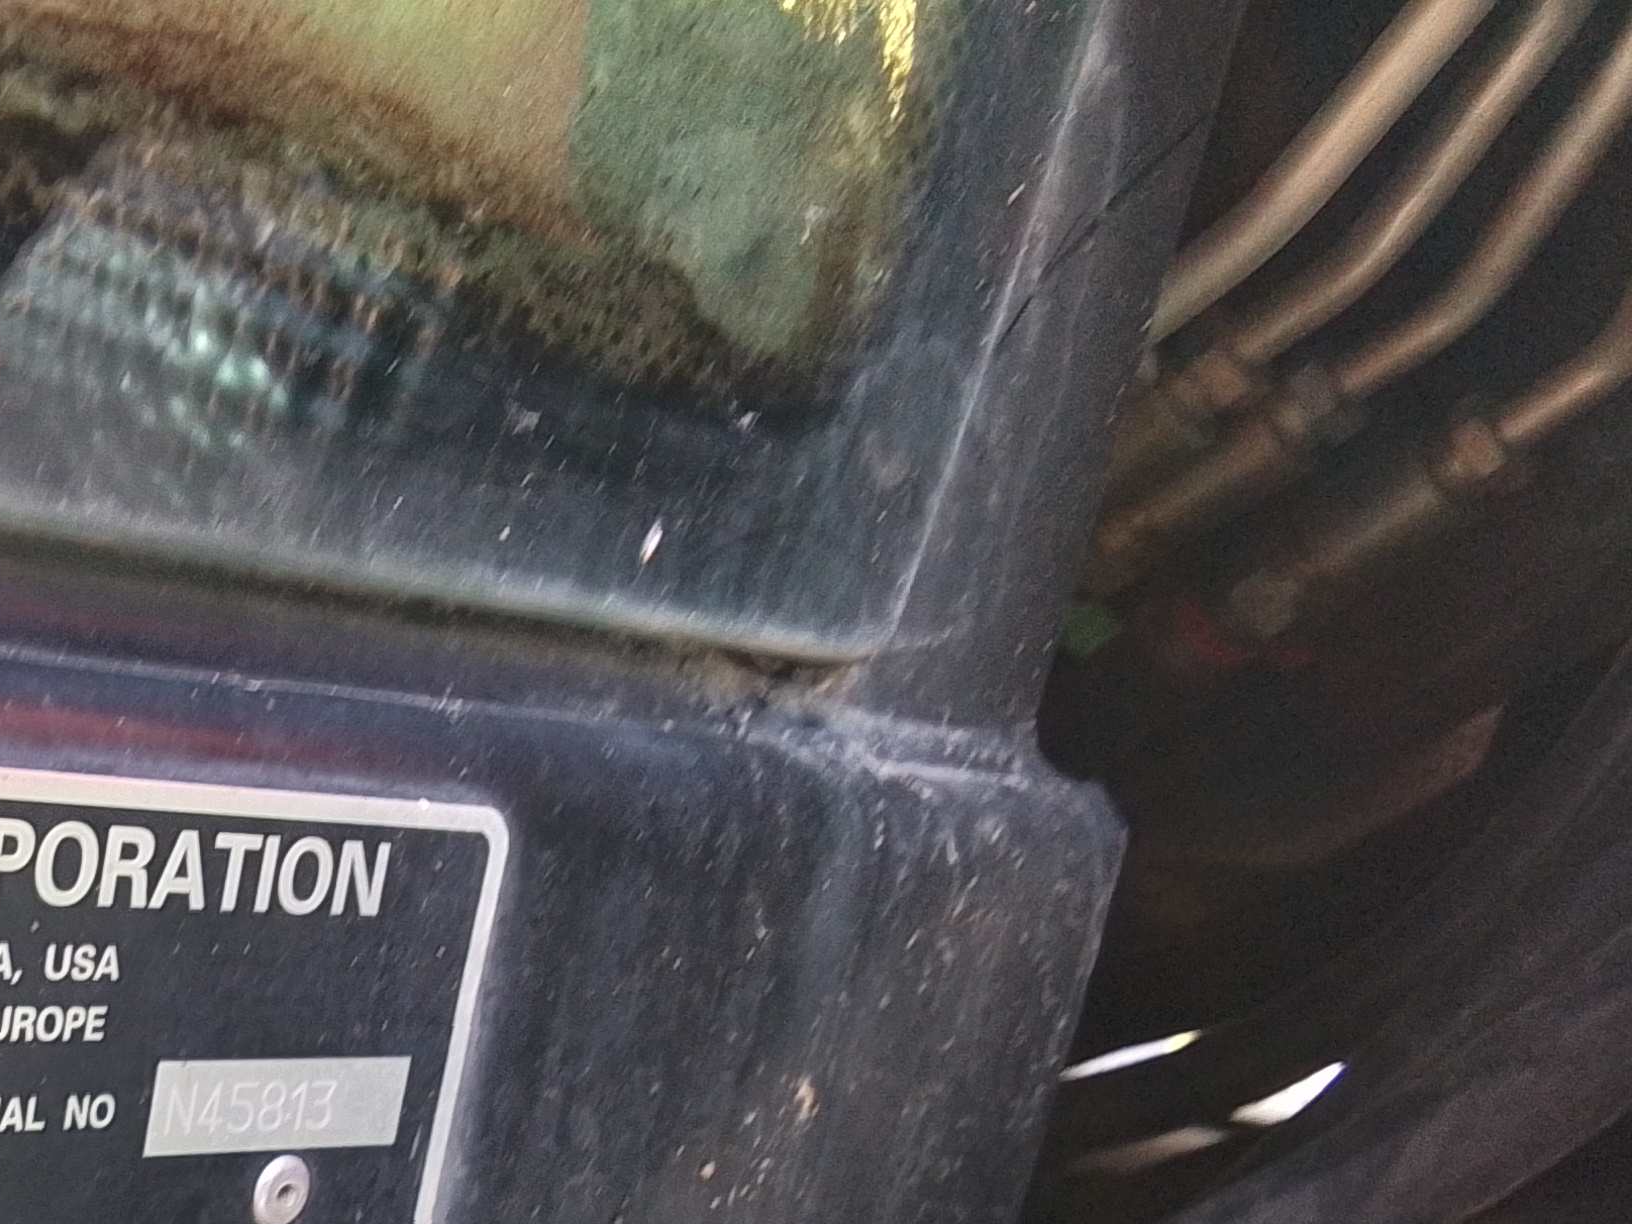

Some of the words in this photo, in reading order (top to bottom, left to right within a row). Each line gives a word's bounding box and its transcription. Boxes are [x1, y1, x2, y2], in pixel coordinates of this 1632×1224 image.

[44, 944, 119, 981] USA
[64, 1093, 116, 1130] NO
[166, 1079, 338, 1136] N45813
